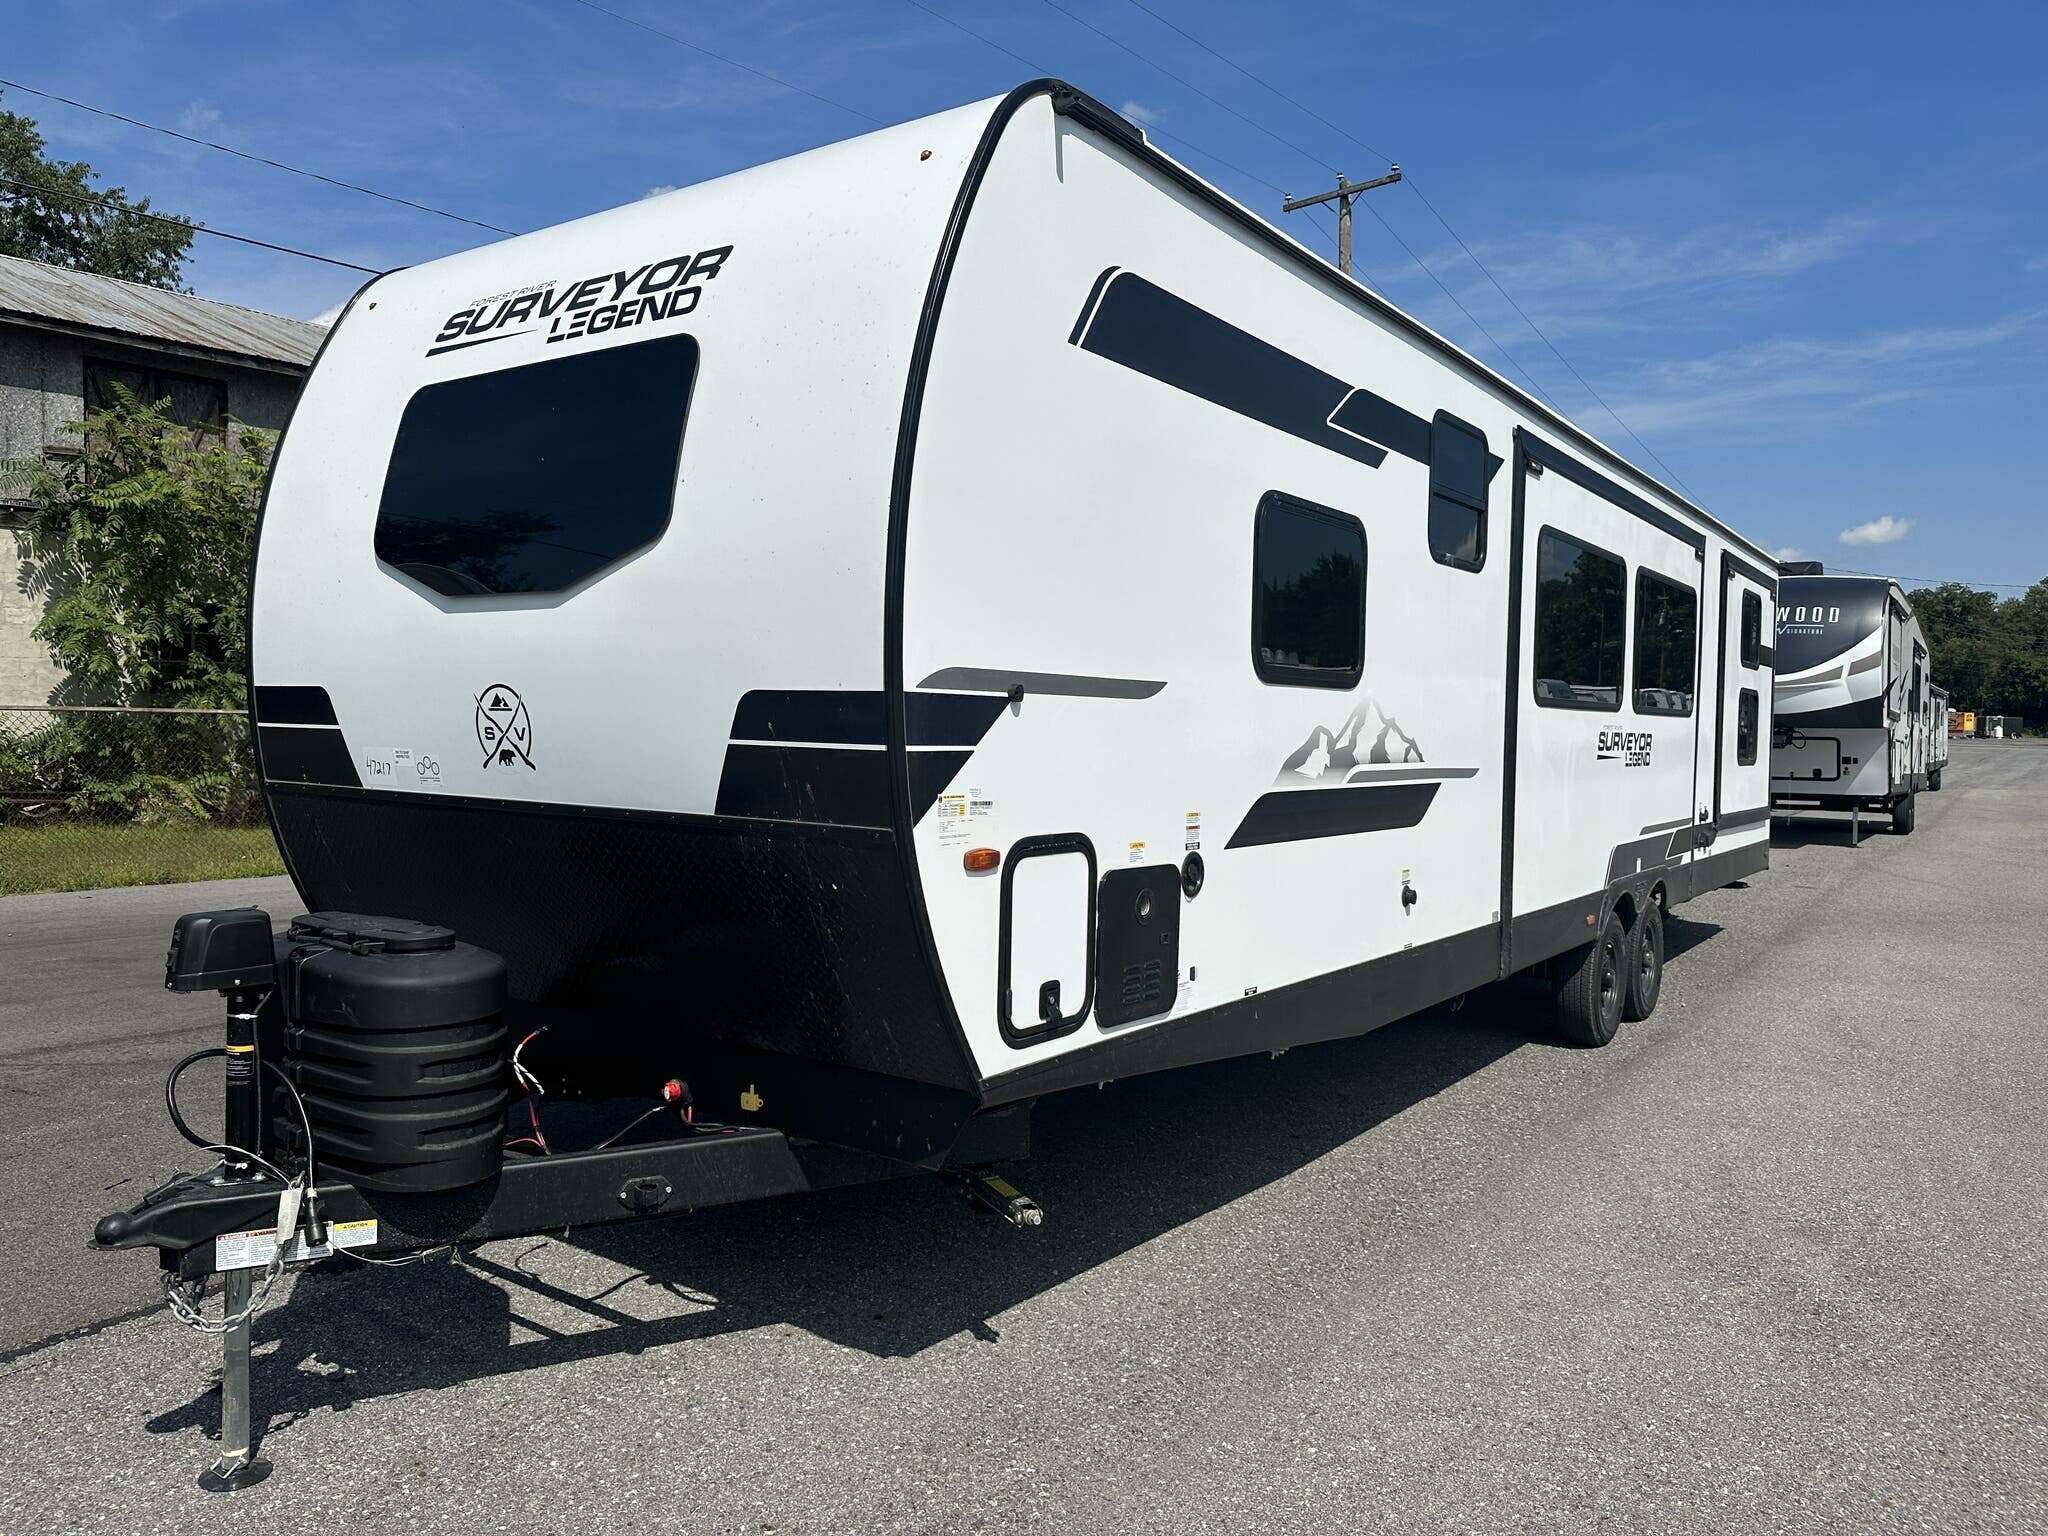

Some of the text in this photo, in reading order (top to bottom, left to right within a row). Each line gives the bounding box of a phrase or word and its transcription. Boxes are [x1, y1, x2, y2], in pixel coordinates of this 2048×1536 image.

[435, 245, 734, 342] SURVEYOR
[546, 286, 702, 344] LEGEND
[484, 726, 526, 741] S V
[1597, 731, 1653, 751] SURVEYOR
[1625, 752, 1651, 767] LEGEND
